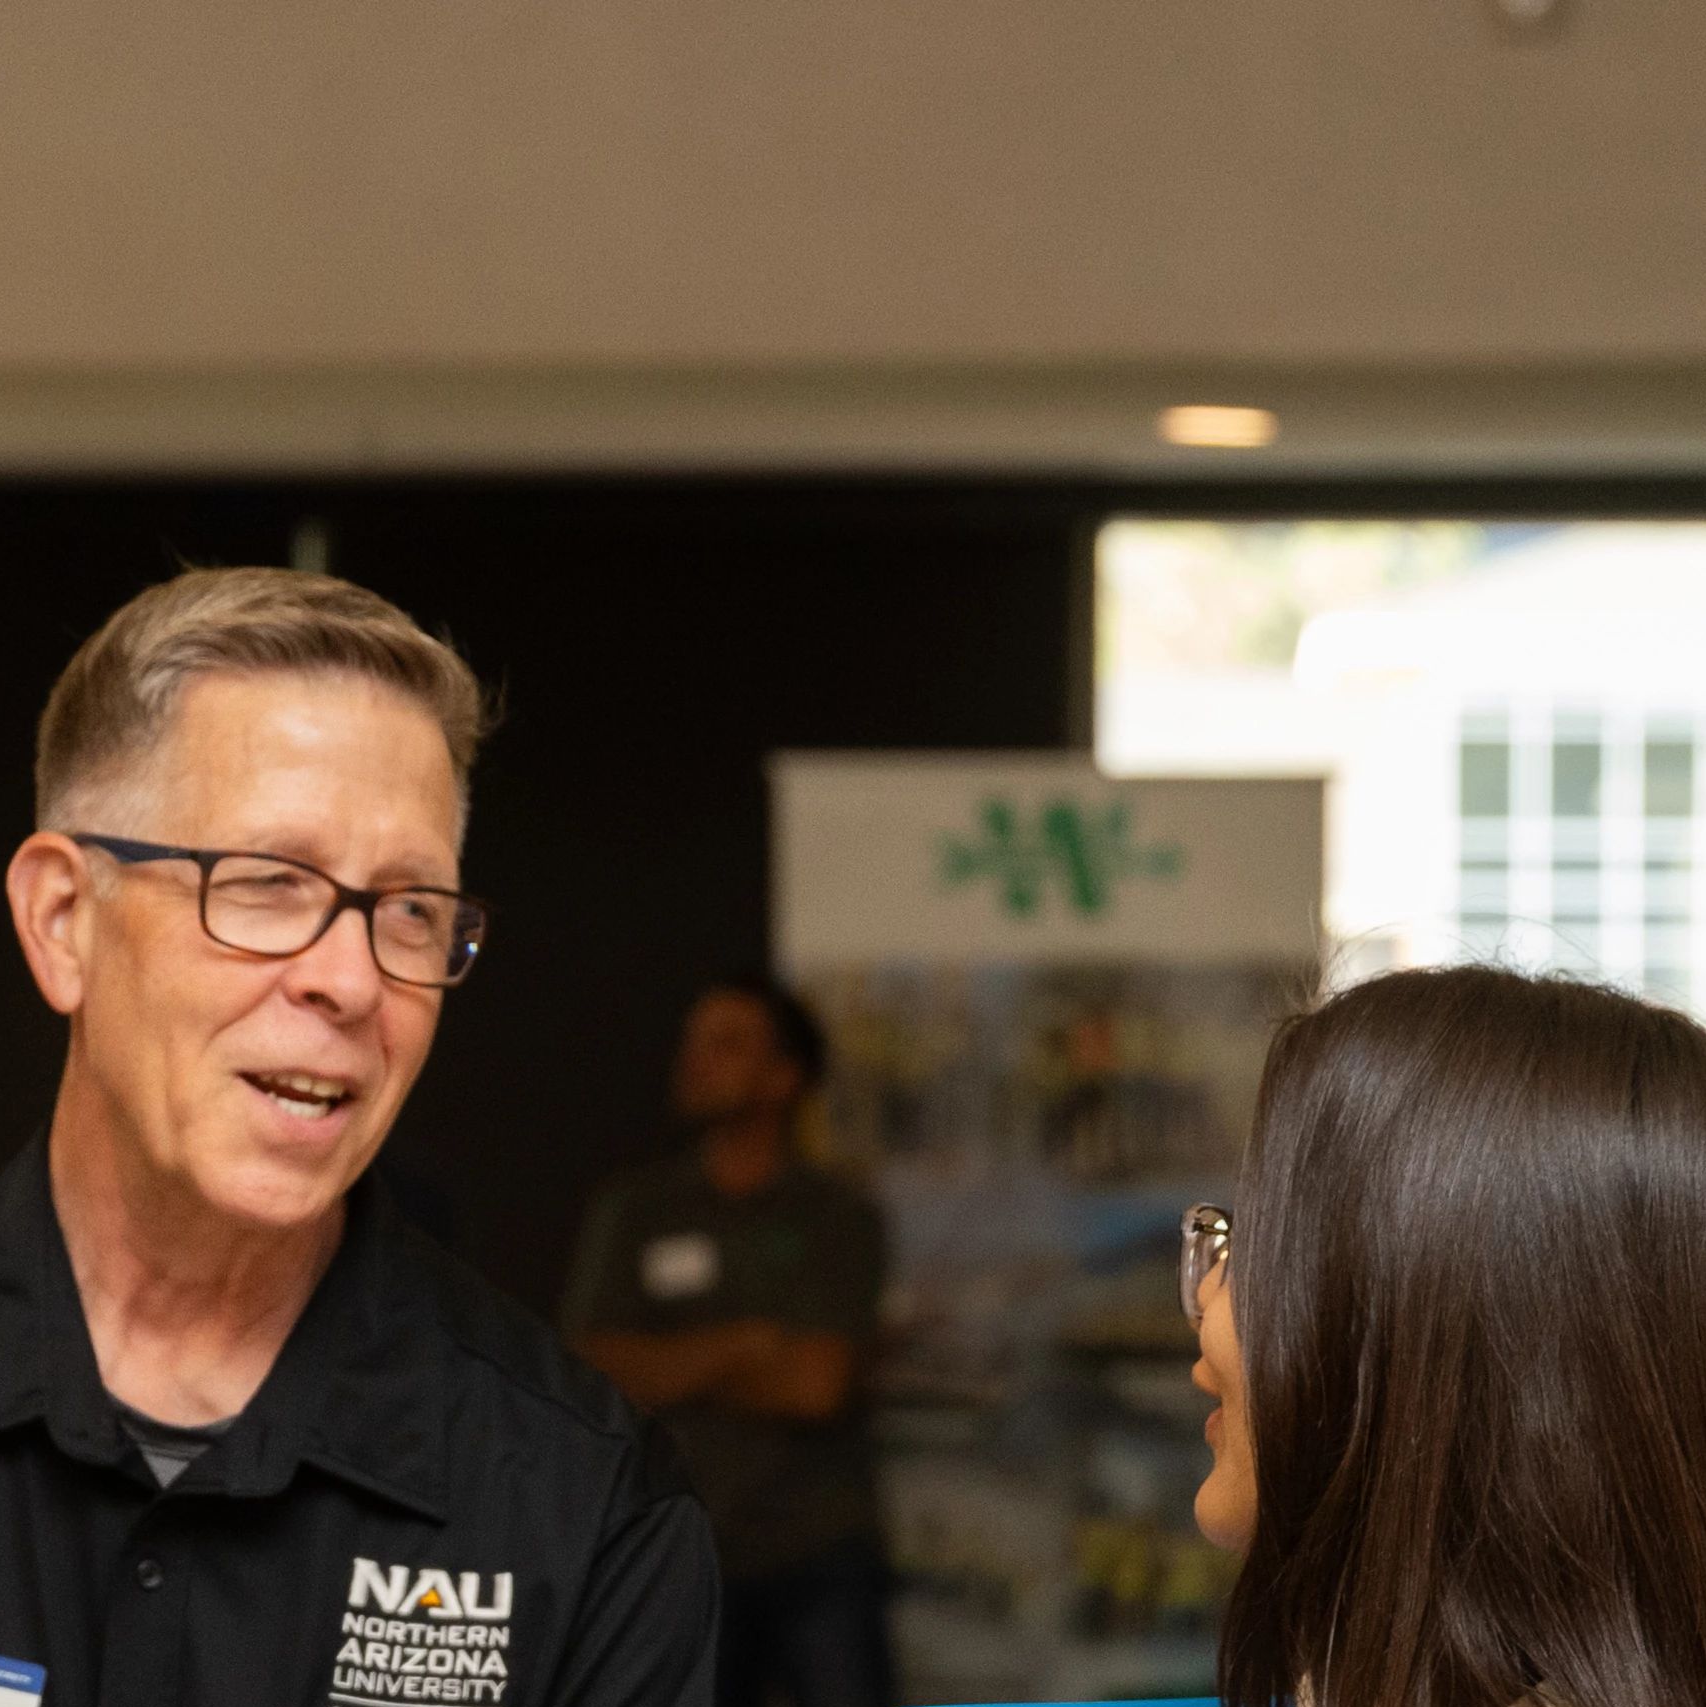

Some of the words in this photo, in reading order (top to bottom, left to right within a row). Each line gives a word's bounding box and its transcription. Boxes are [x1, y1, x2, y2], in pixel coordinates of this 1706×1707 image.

[348, 1557, 513, 1620] NAU
[341, 1612, 510, 1649] NORTHERN
[336, 1637, 509, 1678] ARIZONA
[332, 1666, 508, 1703] UNIVERSITY
